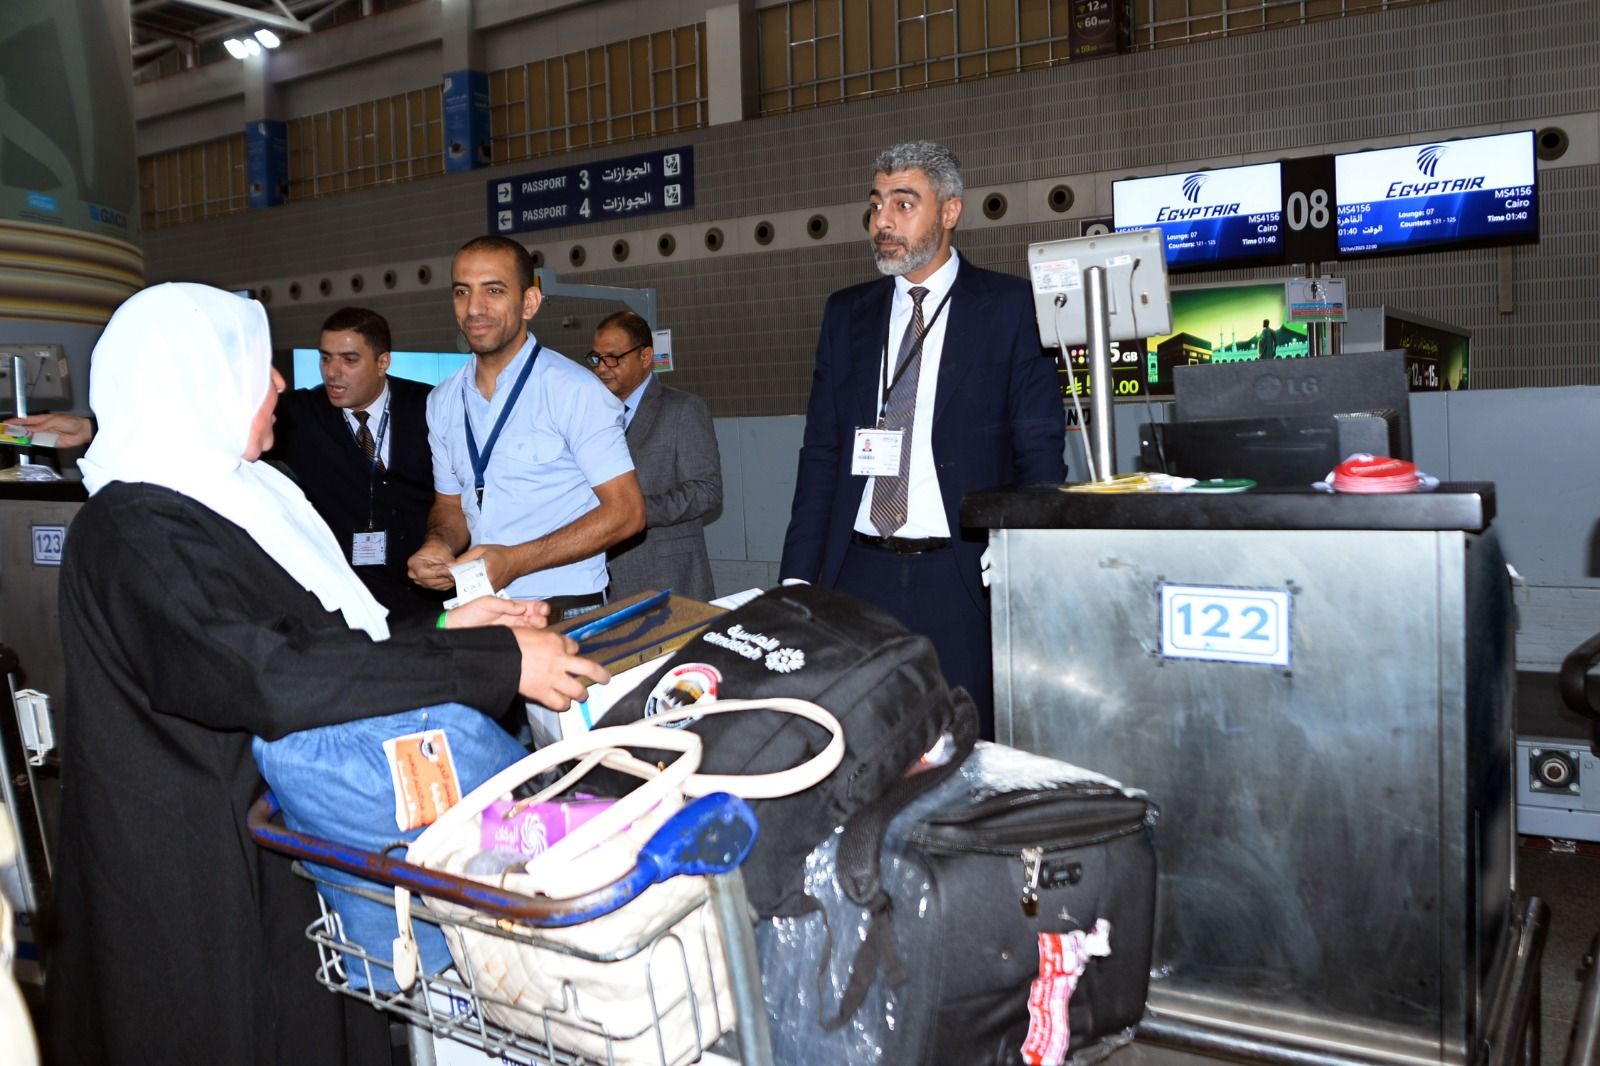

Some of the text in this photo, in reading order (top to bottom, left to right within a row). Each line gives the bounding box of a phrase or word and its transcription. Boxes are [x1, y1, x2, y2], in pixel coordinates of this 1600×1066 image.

[1087, 1, 1099, 11] 12
[1084, 16, 1098, 27] 60
[602, 161, 651, 183] الجوازات
[522, 170, 590, 194] PASSPORT 3
[1386, 176, 1485, 199] EGYPTAIR
[1495, 187, 1532, 199] MS4156
[602, 192, 652, 212] الجوازات
[1505, 199, 1530, 209] Cairo
[522, 198, 591, 222] PASSPORT 4
[1156, 203, 1240, 223] EGYPTAIR
[1287, 189, 1330, 231] 08
[1338, 204, 1371, 215] MS4156
[1398, 211, 1425, 219] Lounge:
[1249, 213, 1280, 224] MS4156
[1337, 215, 1363, 225] القاهرة
[1487, 212, 1528, 223] Time 01:40
[1257, 224, 1278, 233] Cairo
[1400, 219, 1432, 228] Counters:
[1338, 225, 1383, 236] الوقت 01:40
[1242, 236, 1276, 246] Time 01:40
[1122, 351, 1138, 362] GB
[1287, 377, 1319, 396] LG
[36, 533, 61, 554] 123
[1177, 602, 1269, 641] 122
